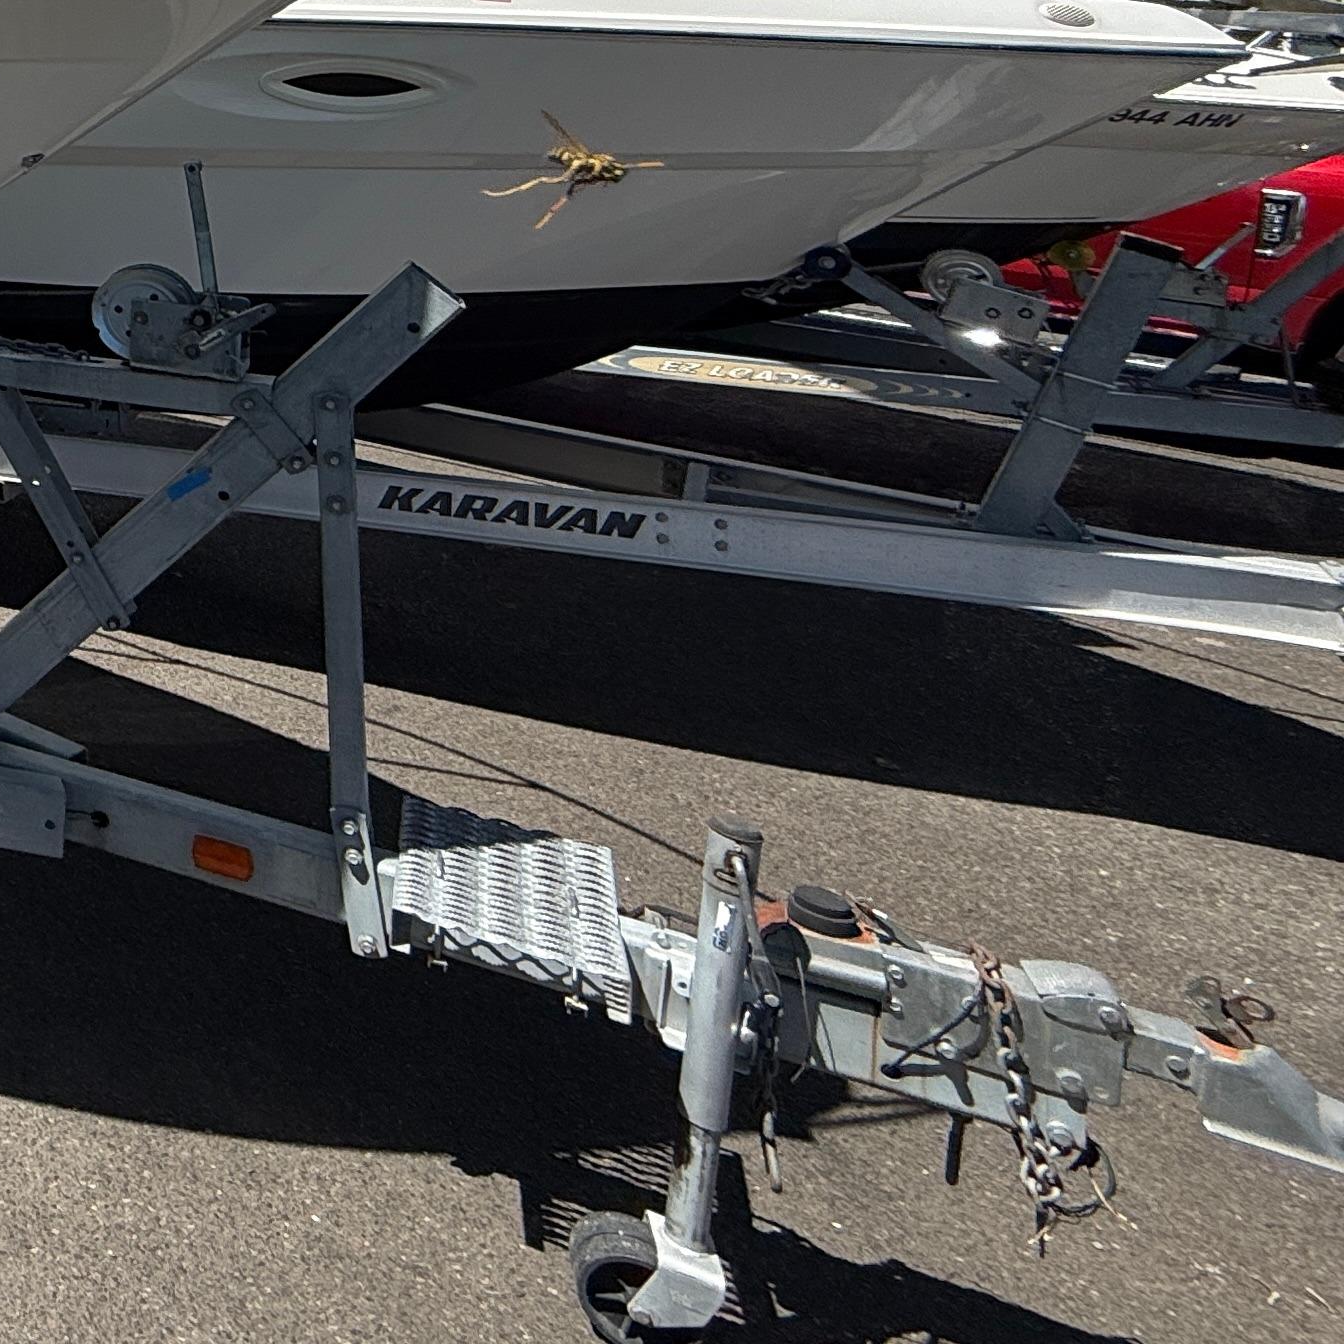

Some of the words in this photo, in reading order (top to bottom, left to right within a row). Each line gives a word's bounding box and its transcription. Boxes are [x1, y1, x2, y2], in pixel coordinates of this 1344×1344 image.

[1173, 112, 1246, 128] AHN
[659, 359, 703, 375] EZ
[378, 485, 647, 540] KARAVAN
